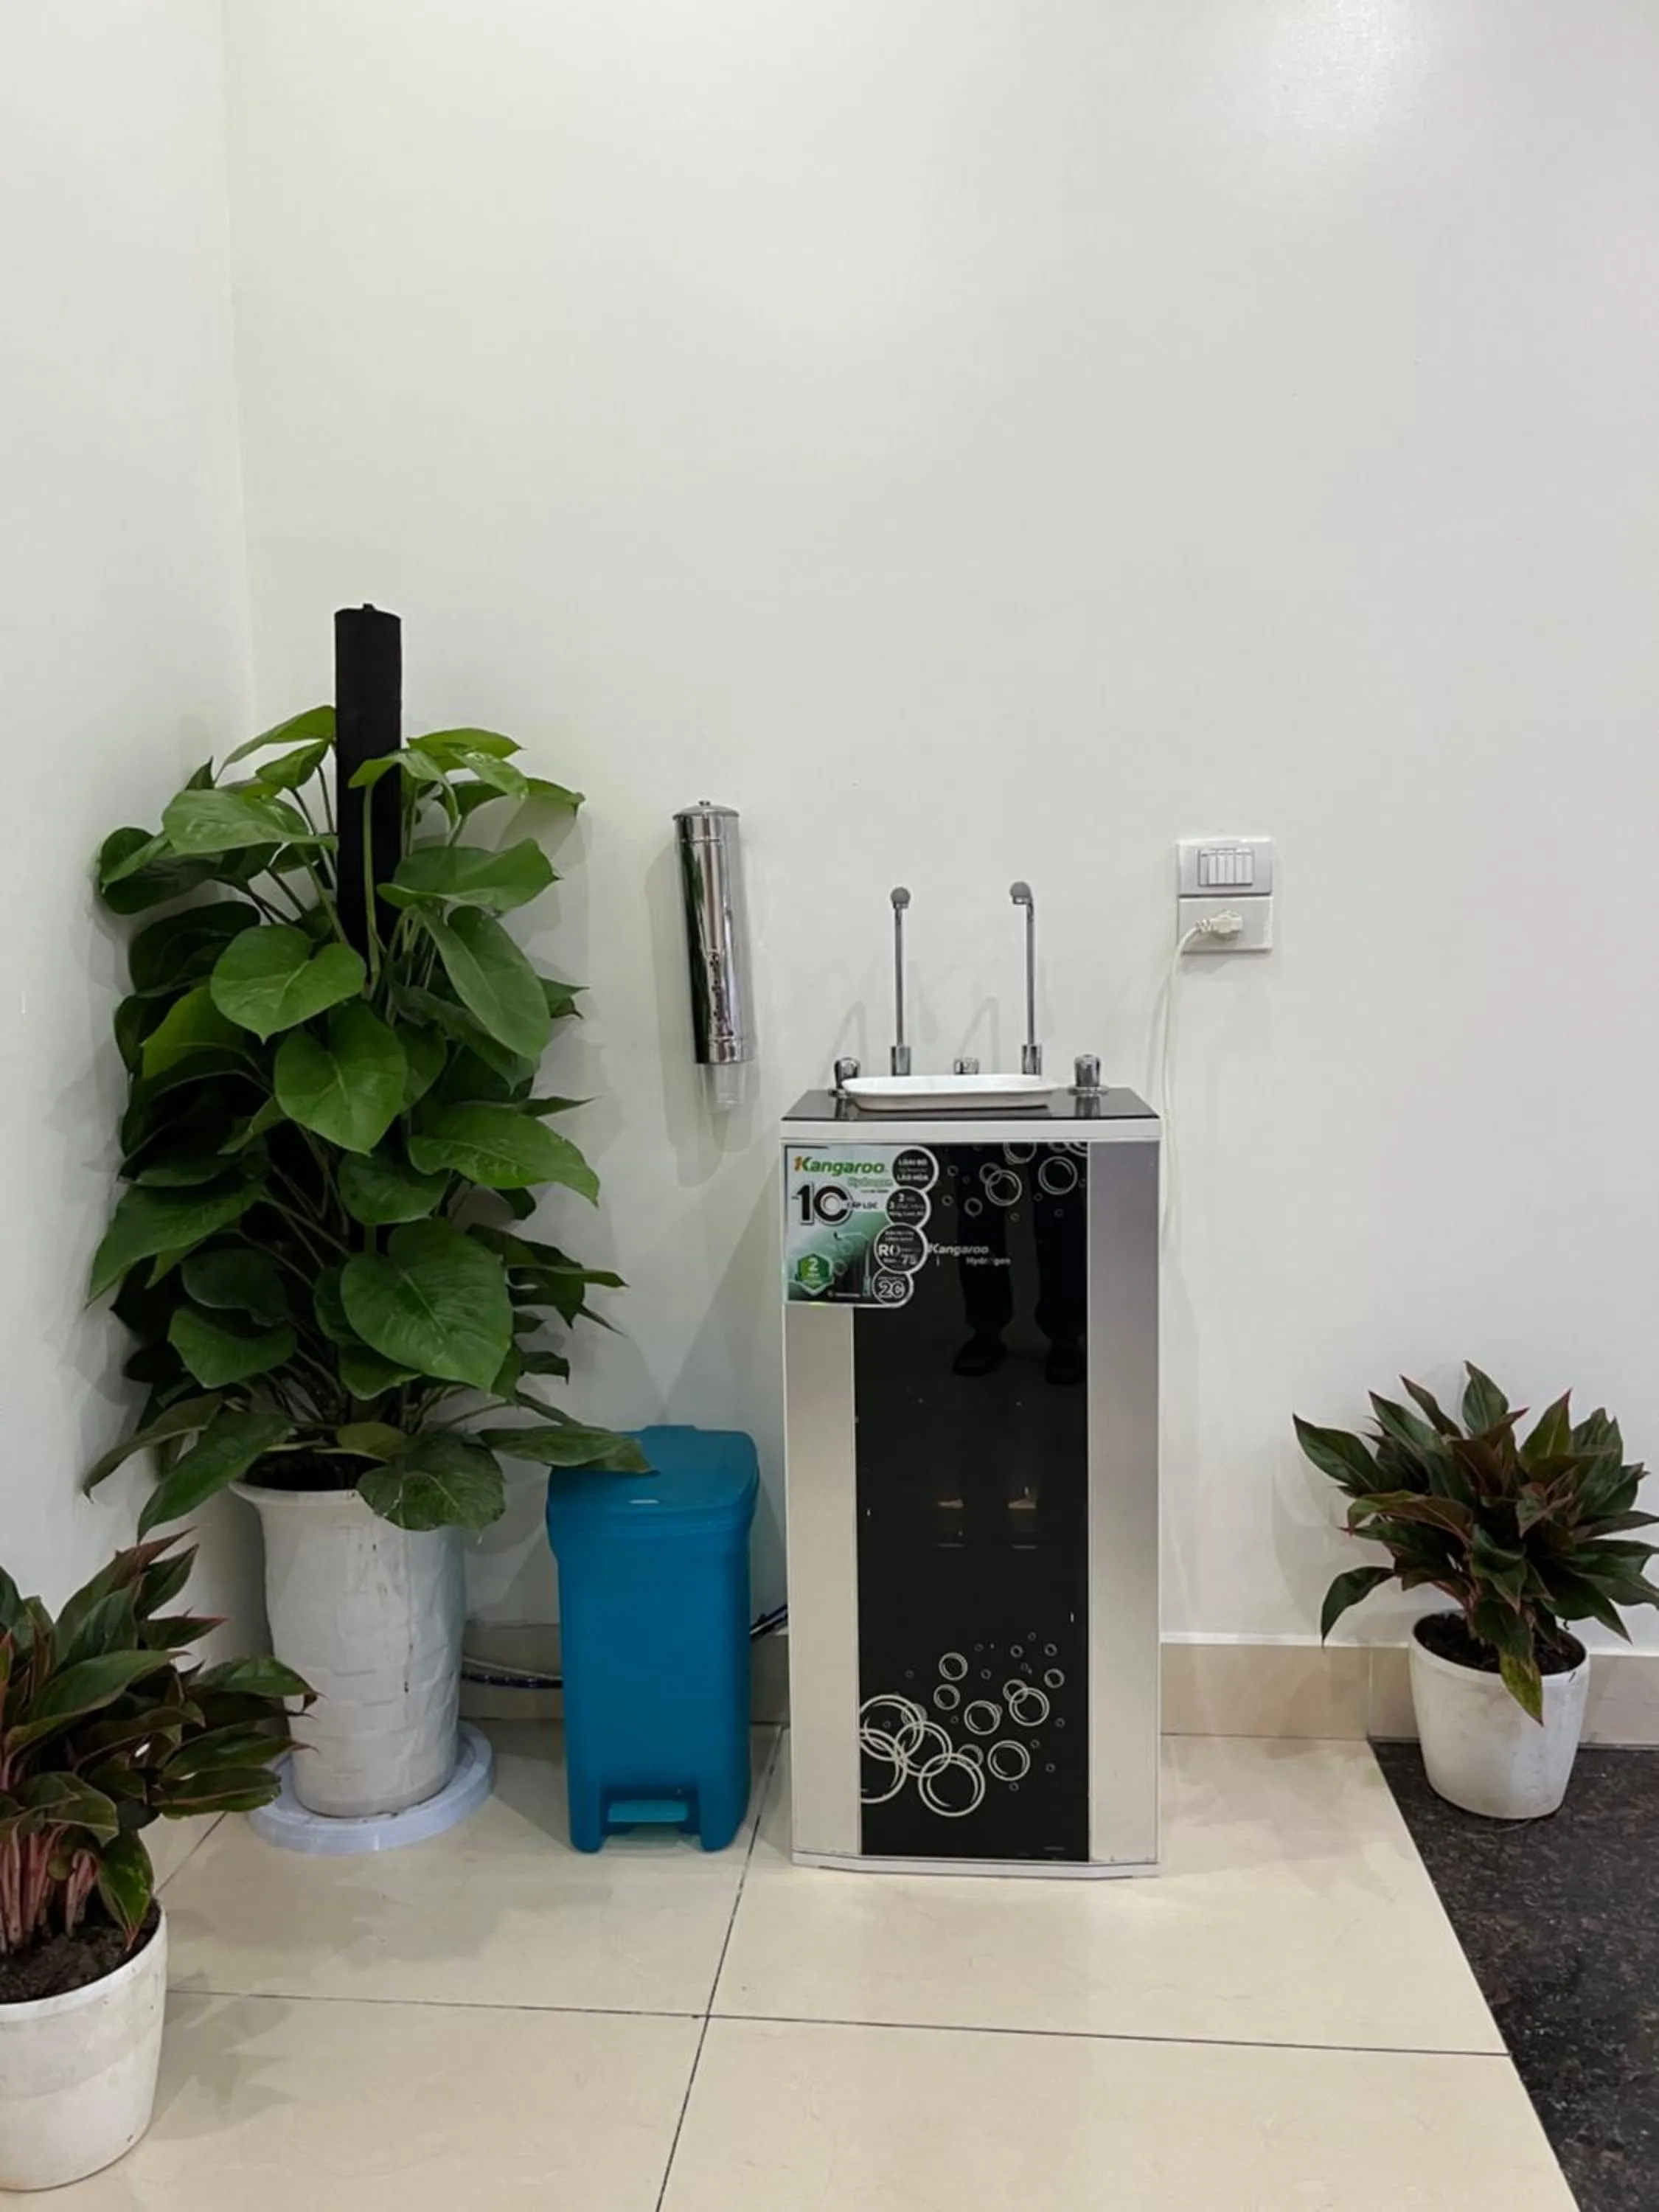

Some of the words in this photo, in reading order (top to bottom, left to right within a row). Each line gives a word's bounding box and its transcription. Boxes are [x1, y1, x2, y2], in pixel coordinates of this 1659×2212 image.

[794, 1156, 886, 1177] Kangaroo
[928, 1242, 989, 1257] Kangaroo
[807, 1257, 818, 1271] 2
[965, 1256, 1011, 1267] Hydrgen
